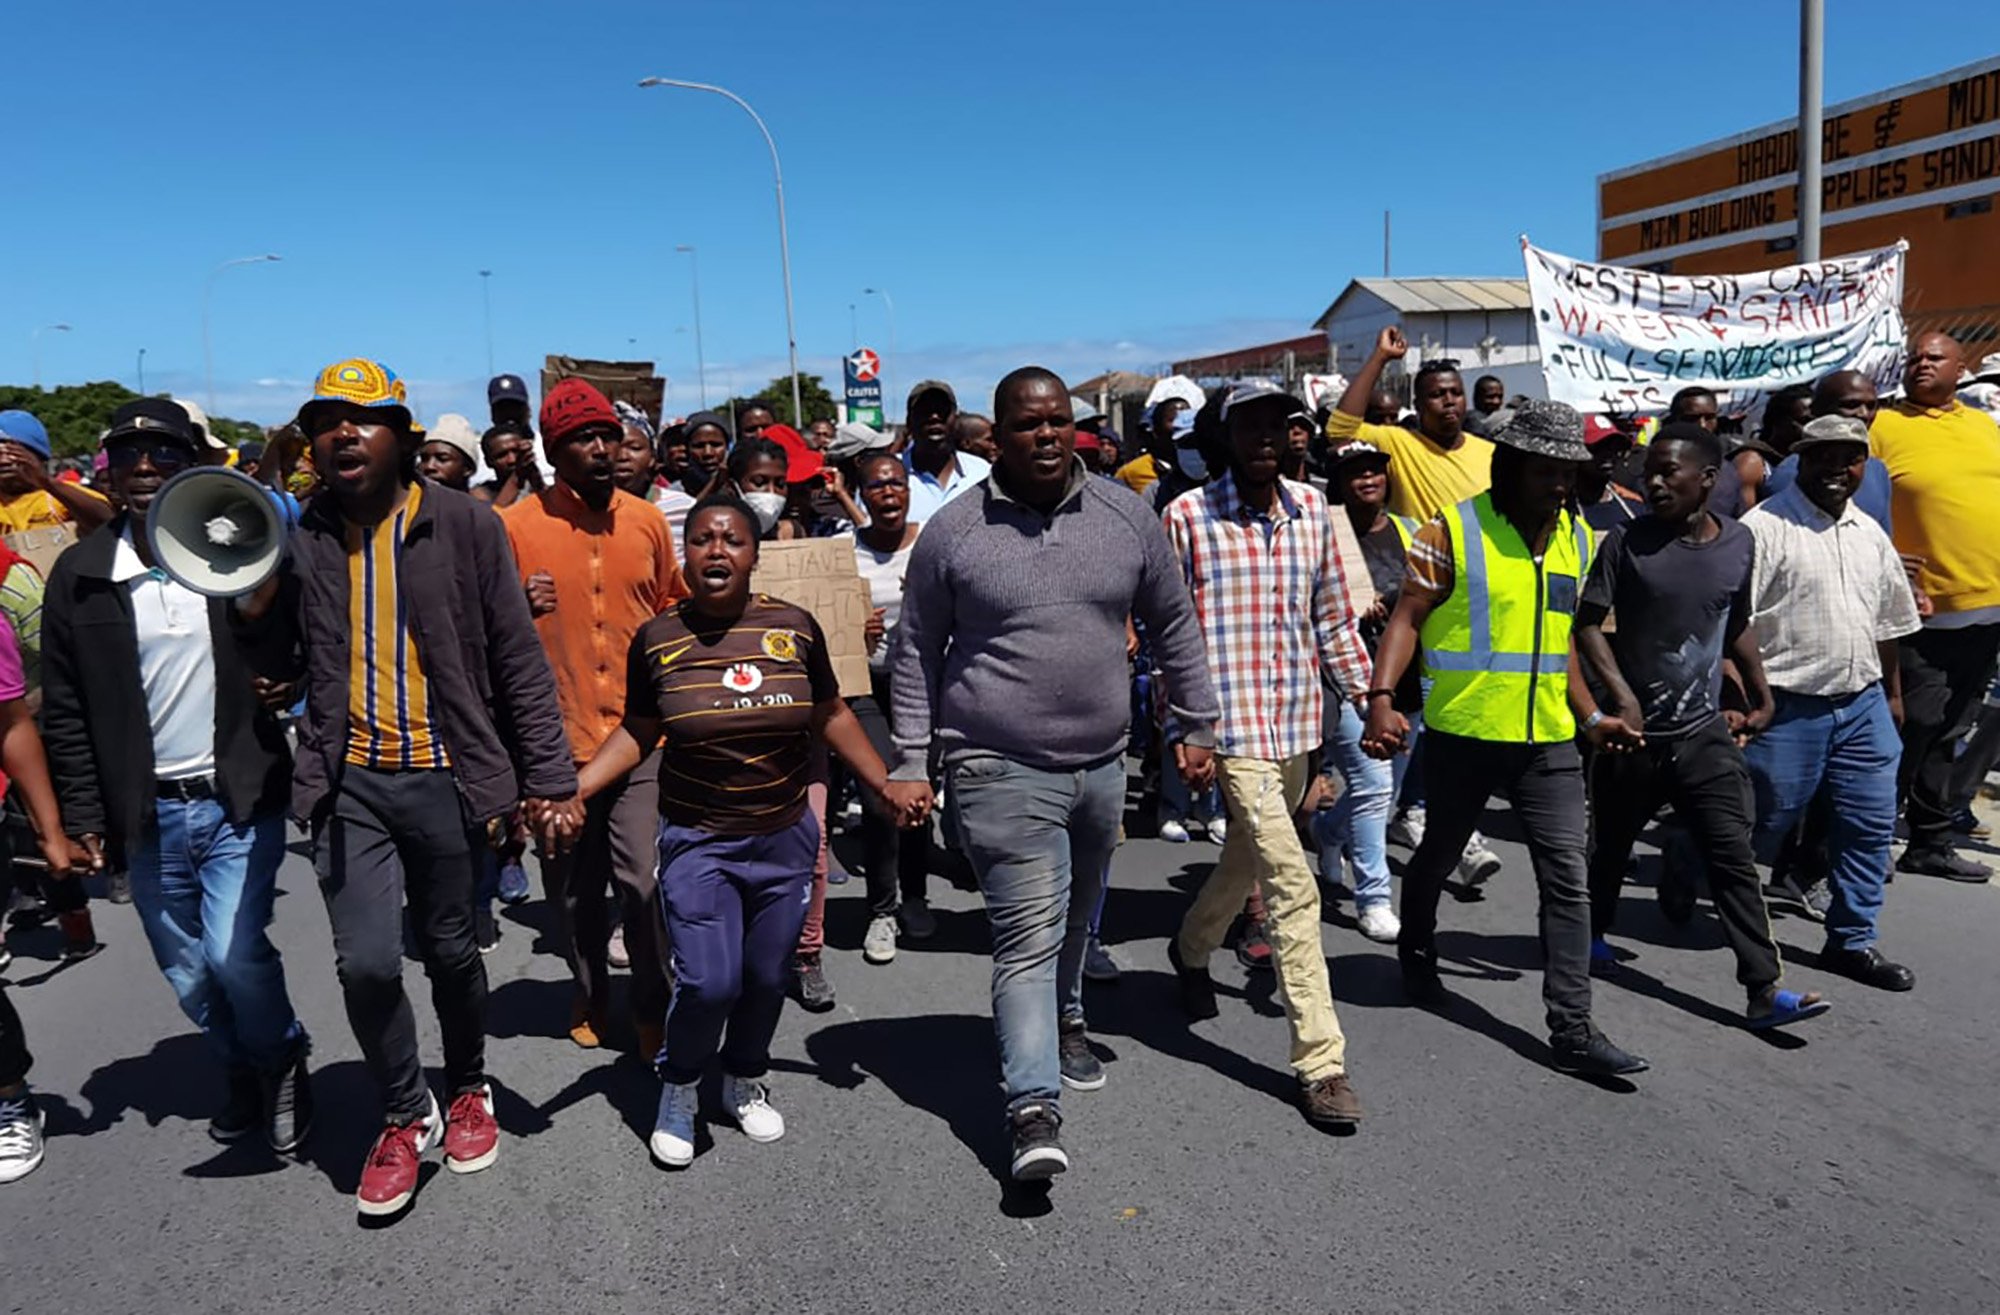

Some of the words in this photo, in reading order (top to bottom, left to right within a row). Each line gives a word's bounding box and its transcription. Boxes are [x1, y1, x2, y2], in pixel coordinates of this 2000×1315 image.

[1738, 113, 1850, 185] HARDRE
[1688, 190, 1777, 241] BUILDING
[1793, 158, 1908, 216] PPLIES
[1922, 134, 2000, 189] SAND
[1768, 260, 1858, 293] CAPE
[785, 546, 854, 575] HAVE
